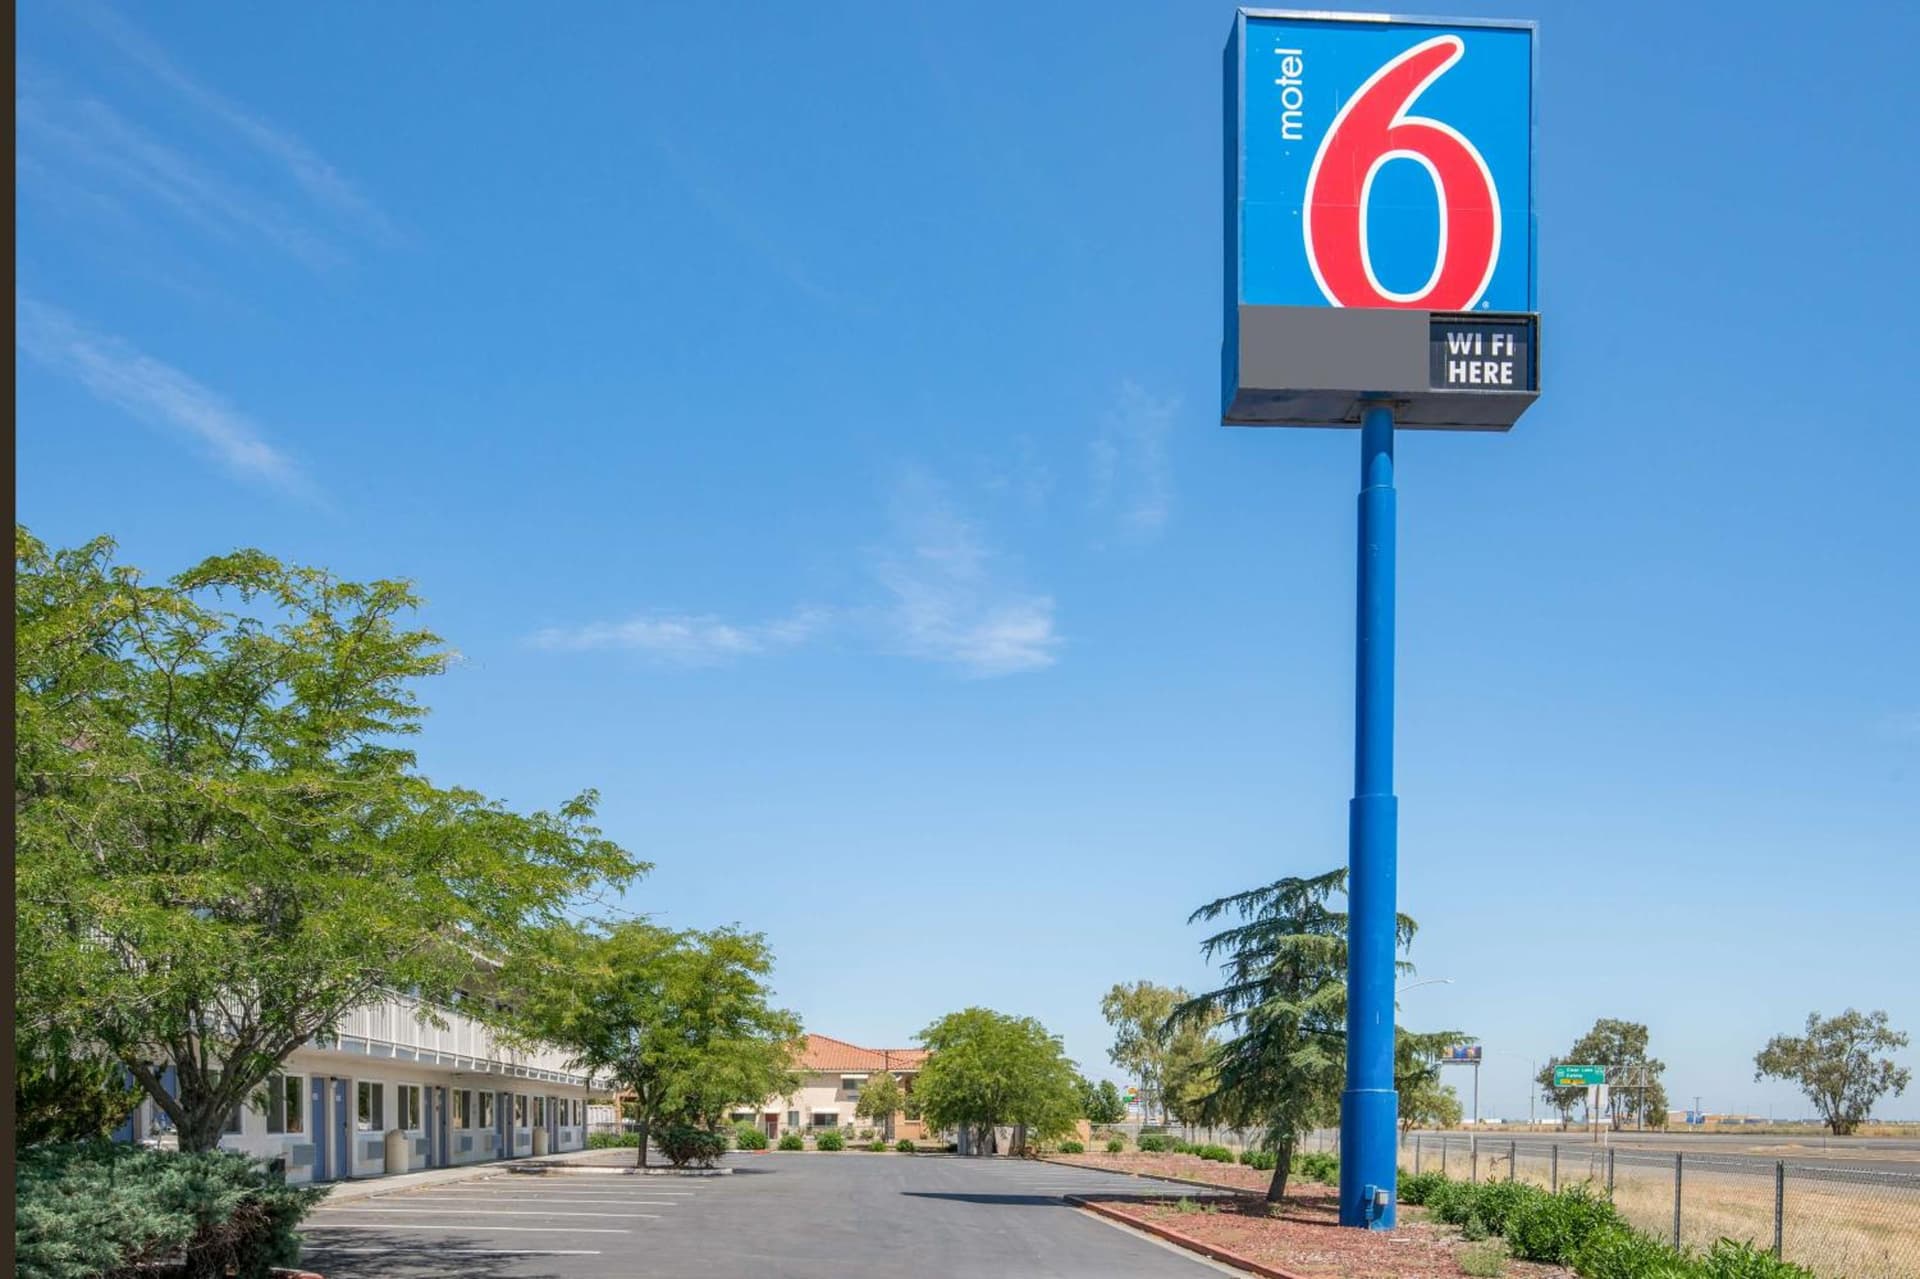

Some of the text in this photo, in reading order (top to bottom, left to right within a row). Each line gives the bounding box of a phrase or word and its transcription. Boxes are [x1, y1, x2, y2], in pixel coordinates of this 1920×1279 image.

[1274, 48, 1303, 140] motel
[1303, 34, 1502, 311] 6
[1447, 332, 1514, 356] WI FI
[1449, 361, 1512, 384] HERE
